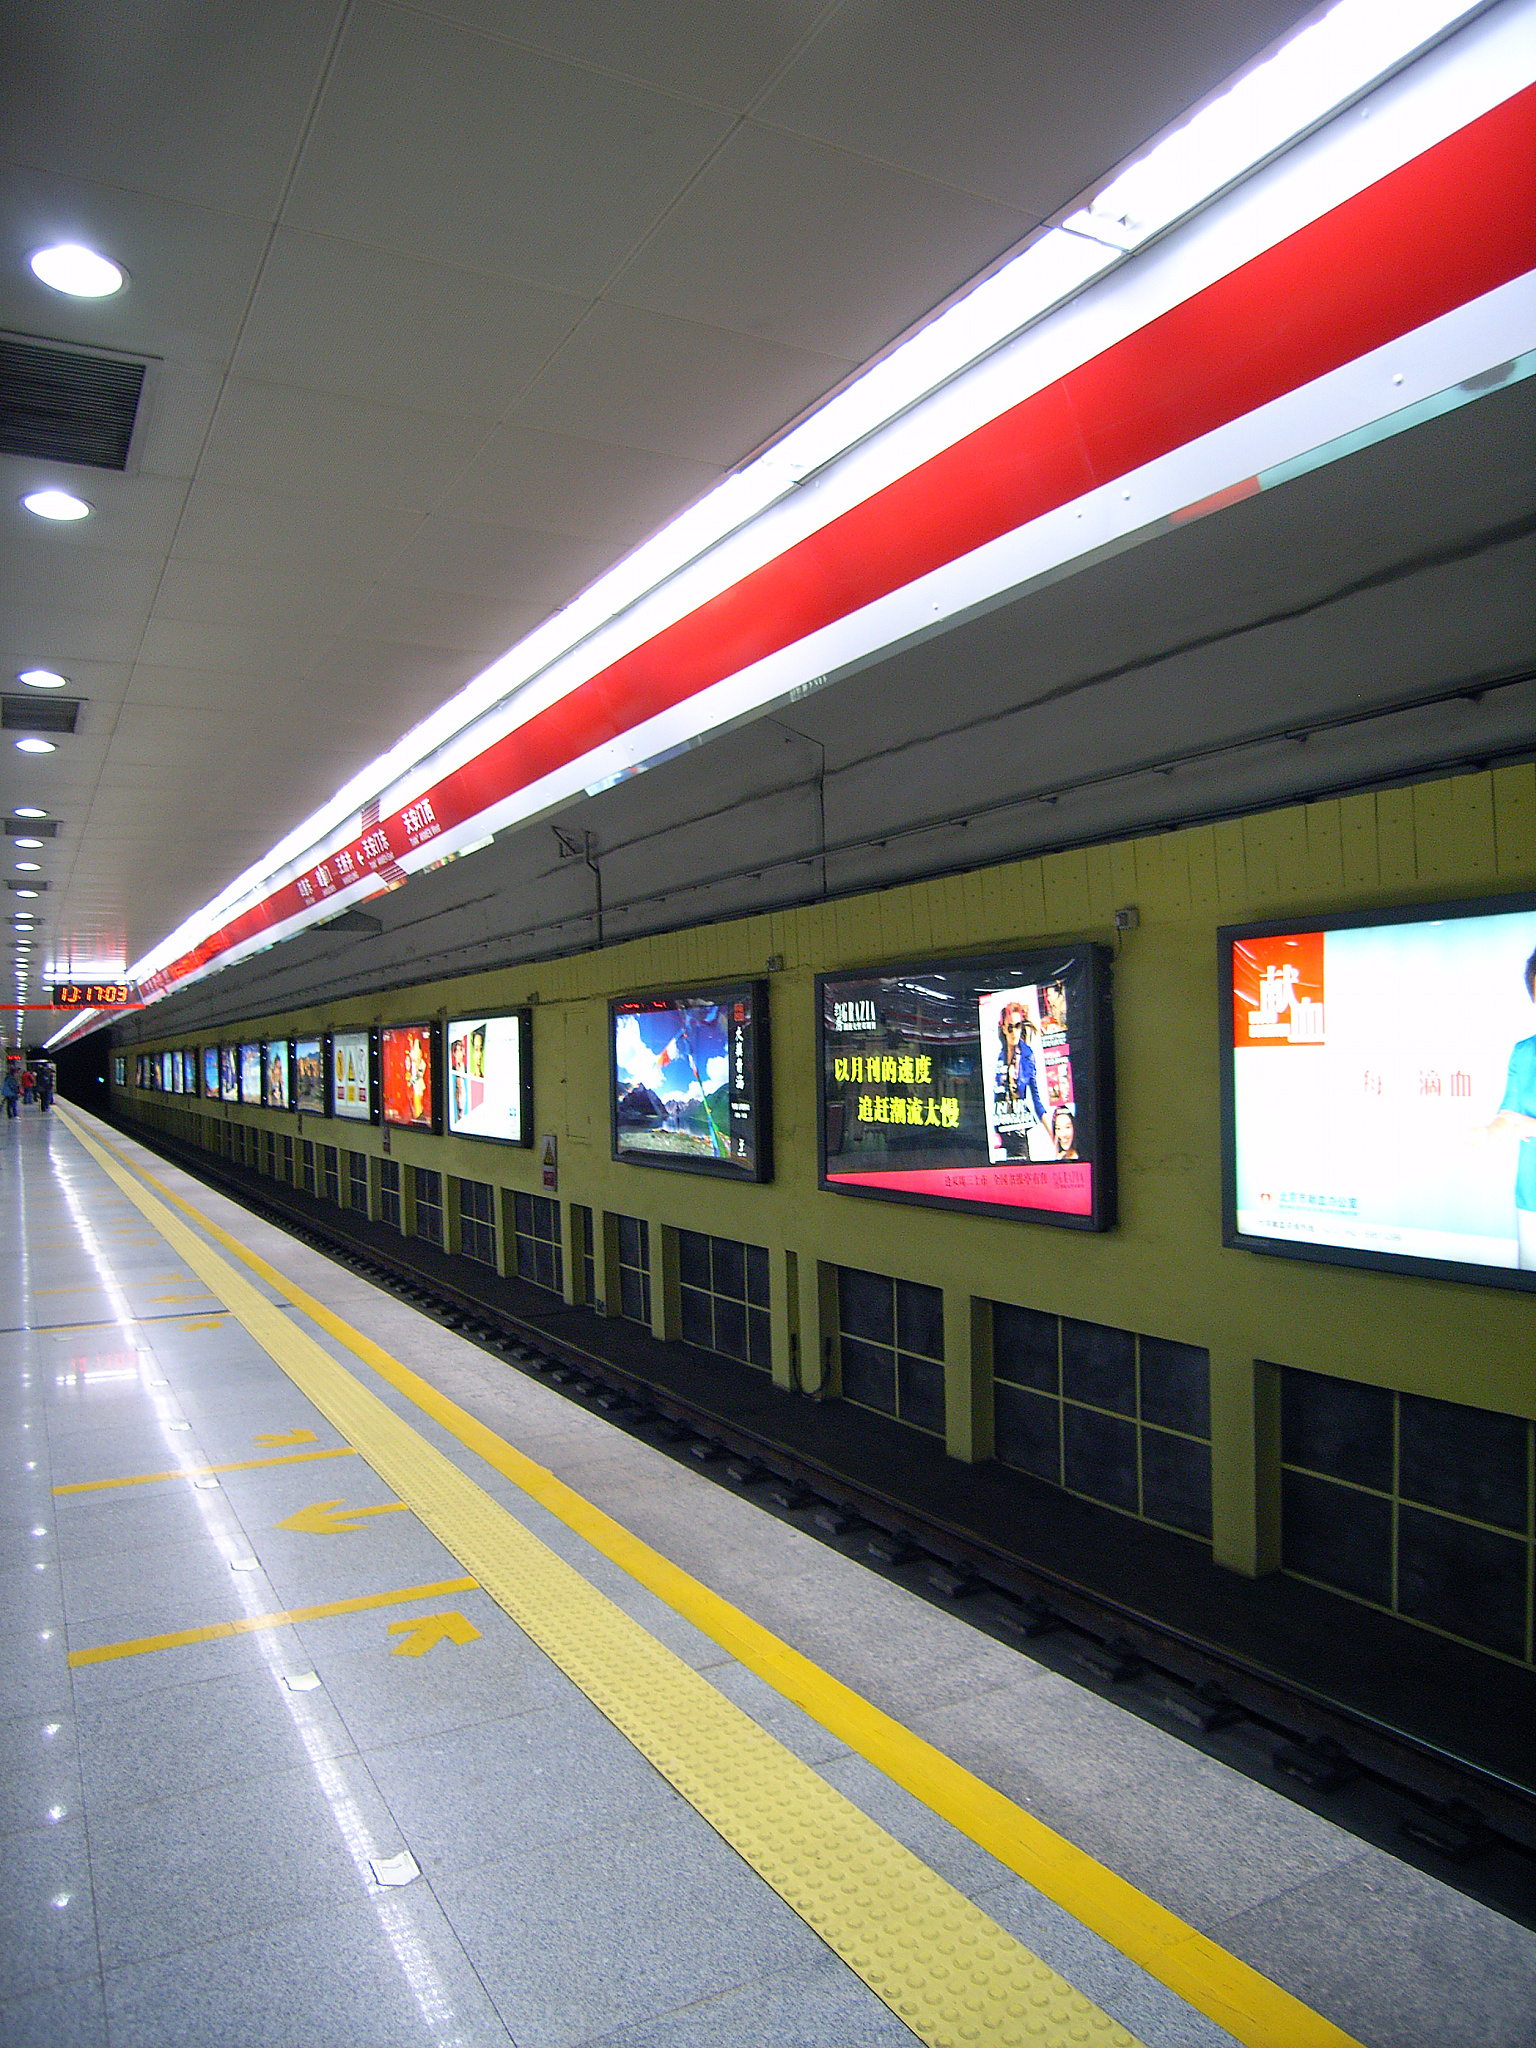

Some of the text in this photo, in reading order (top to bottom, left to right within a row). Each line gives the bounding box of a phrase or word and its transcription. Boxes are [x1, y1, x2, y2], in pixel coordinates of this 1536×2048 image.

[401, 798, 436, 835] 天安门西
[361, 828, 390, 859] 天安门东
[842, 1000, 877, 1022] GRAZIA
[1259, 964, 1325, 1044] 献血
[834, 1055, 932, 1084] 以月刊的速度
[858, 1095, 960, 1129] 追赶潮流太慢
